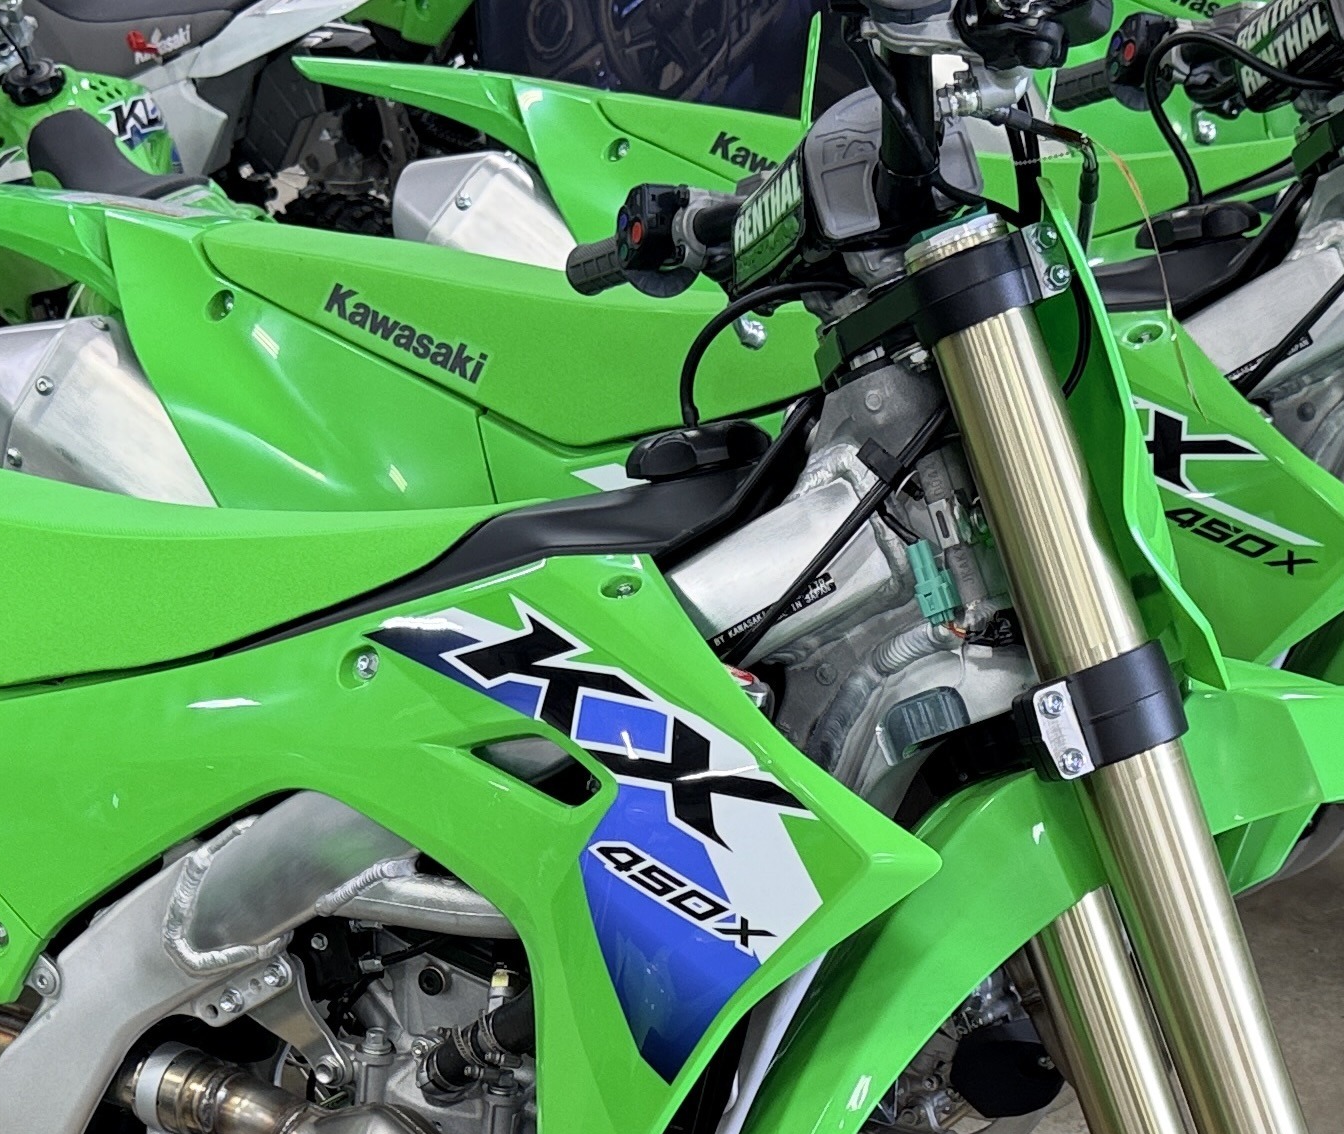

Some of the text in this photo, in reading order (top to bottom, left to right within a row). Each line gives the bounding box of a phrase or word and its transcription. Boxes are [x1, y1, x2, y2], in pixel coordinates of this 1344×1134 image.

[734, 158, 802, 255] RENTHAL
[324, 283, 488, 384] Kawasaki
[456, 611, 809, 852] KX
